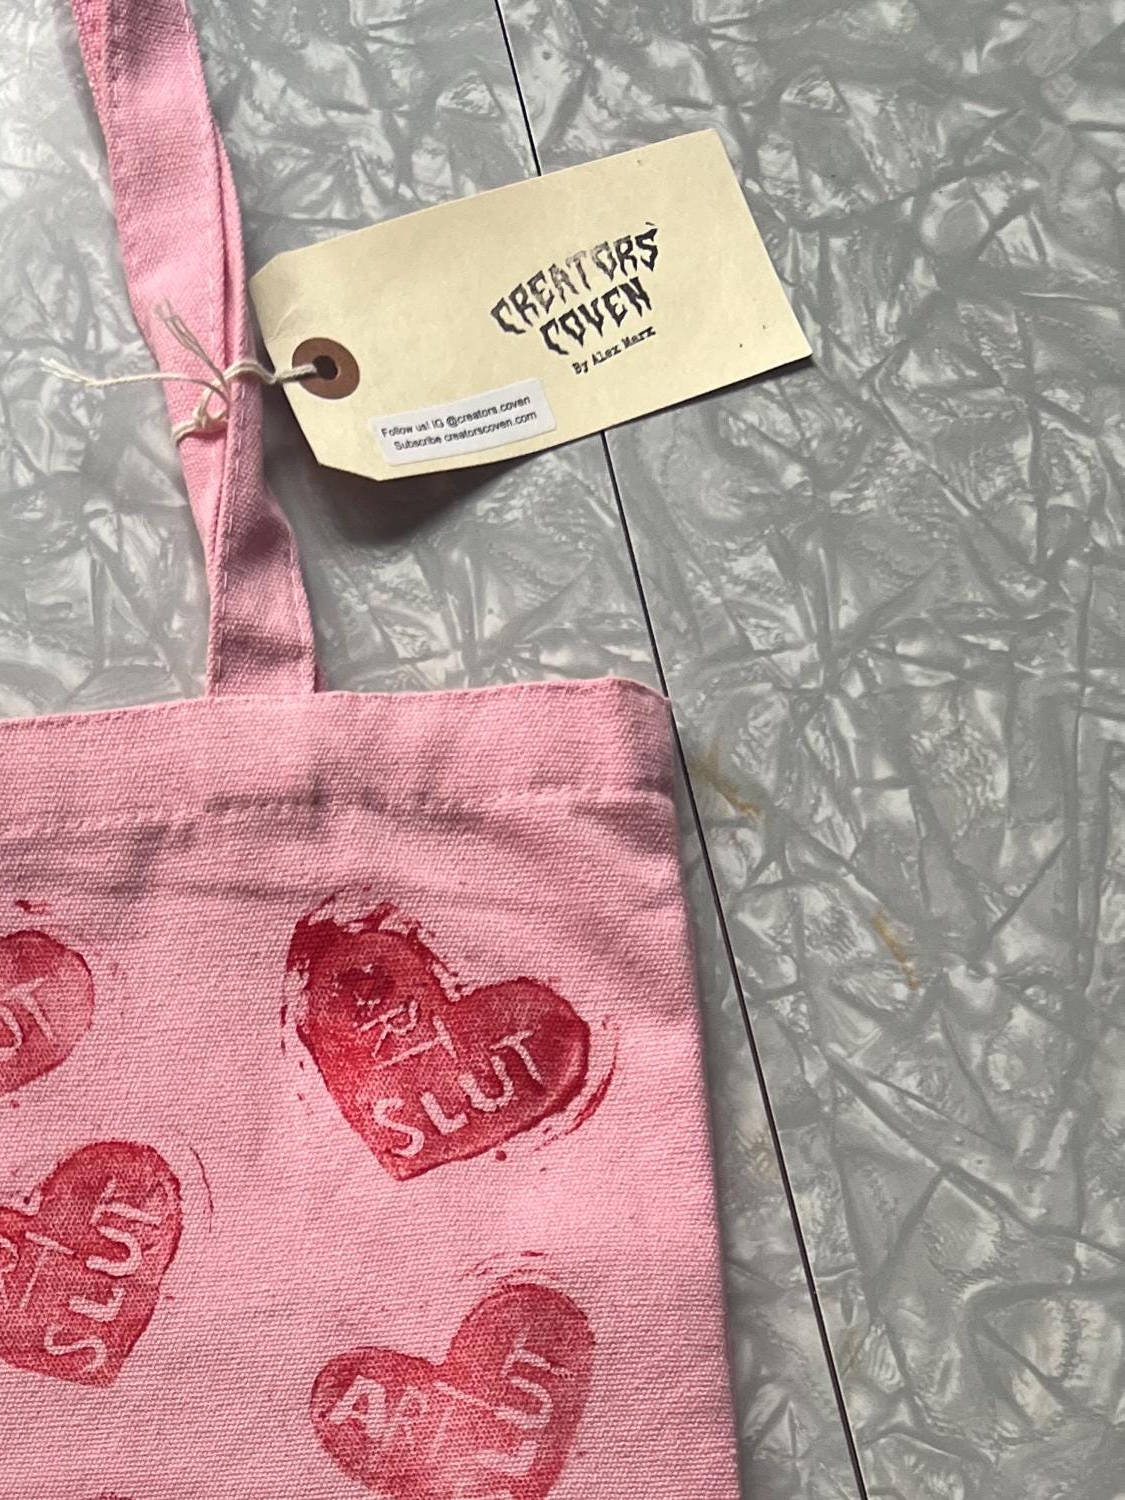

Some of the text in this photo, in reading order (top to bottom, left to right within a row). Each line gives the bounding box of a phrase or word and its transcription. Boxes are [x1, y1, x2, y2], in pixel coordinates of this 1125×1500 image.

[490, 227, 658, 335] CREATORS
[539, 276, 652, 355] COVEN
[572, 360, 588, 375] By
[591, 345, 622, 366] Alex
[381, 425, 413, 438] Follow
[416, 420, 429, 432] us!
[432, 418, 444, 430] IG
[394, 411, 537, 451] Subscribe creatorscoven.com
[373, 1029, 544, 1157] SLUT
[42, 1176, 165, 1374] SLUT
